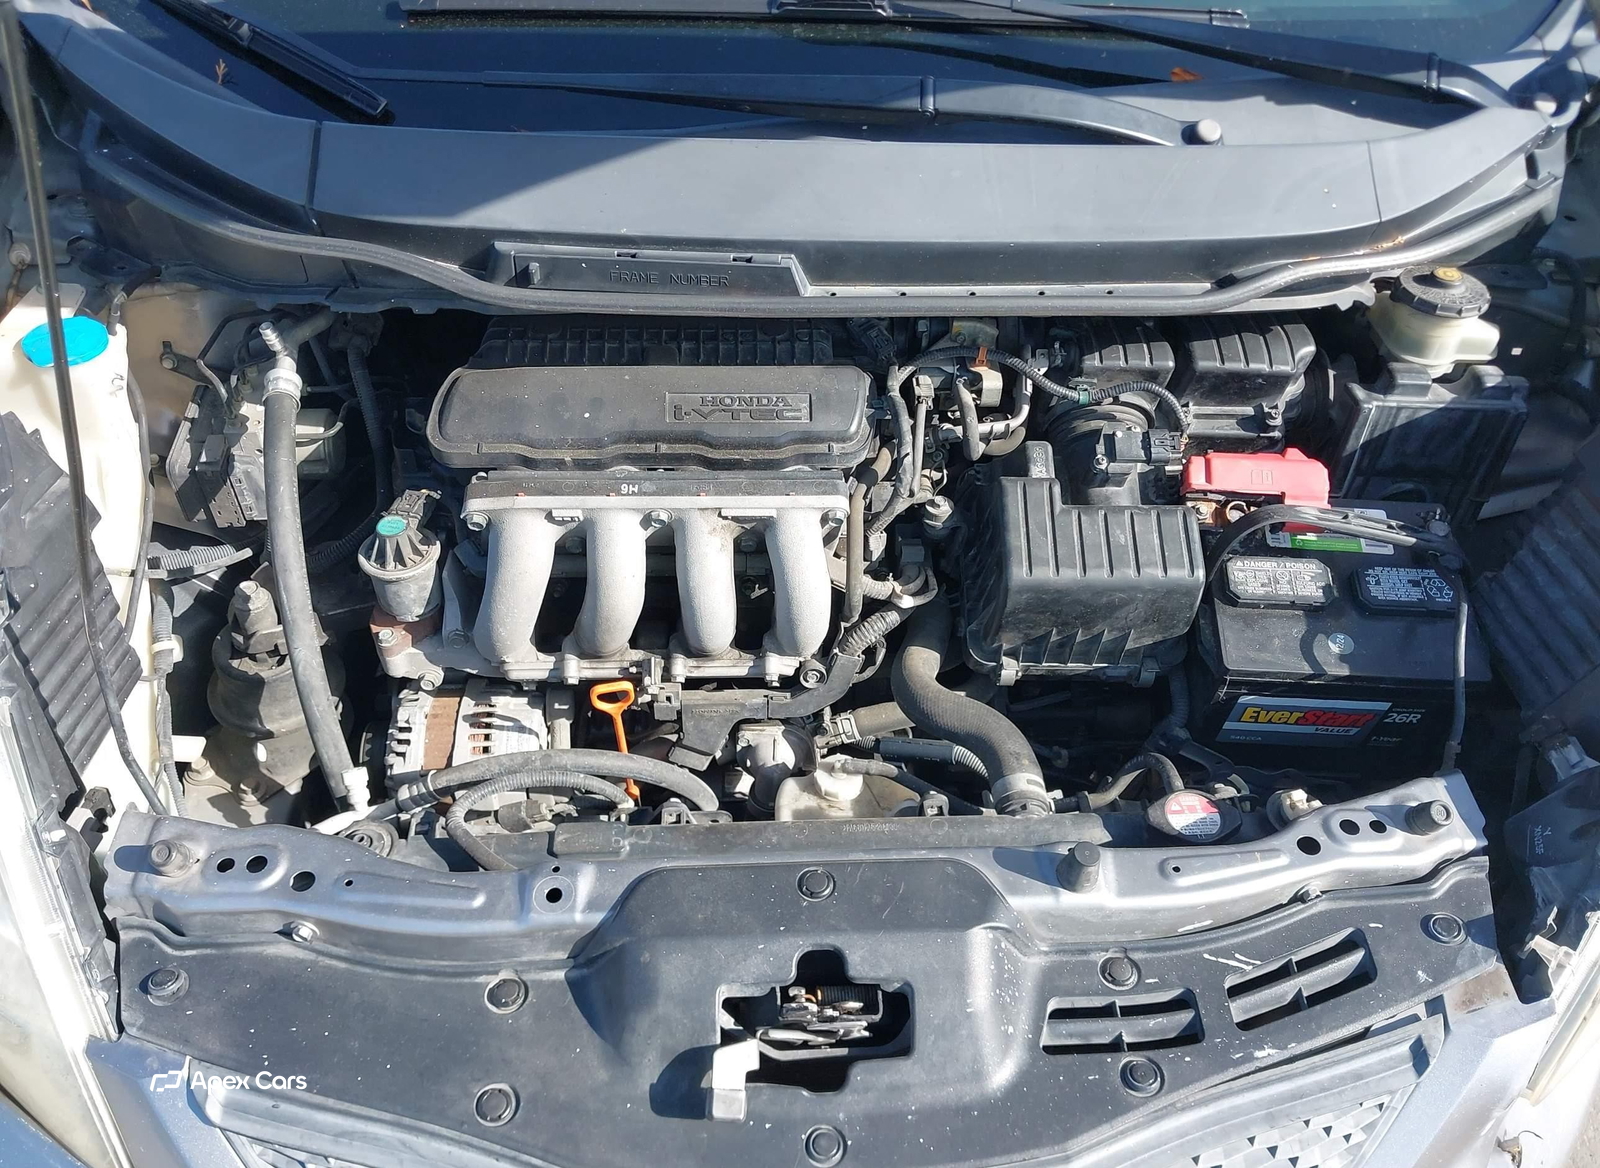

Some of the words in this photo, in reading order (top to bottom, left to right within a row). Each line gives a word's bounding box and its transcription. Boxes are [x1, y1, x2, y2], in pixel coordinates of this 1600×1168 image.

[609, 270, 659, 284] FRAME
[669, 273, 730, 288] NUMBER
[699, 395, 793, 408] HONDA
[673, 403, 809, 421] i-VTEC
[1244, 560, 1278, 569] DANGER
[1285, 562, 1317, 570] POISON
[1240, 707, 1377, 727] EverStart
[1382, 712, 1422, 725] 26R
[1314, 726, 1353, 734] VALUE
